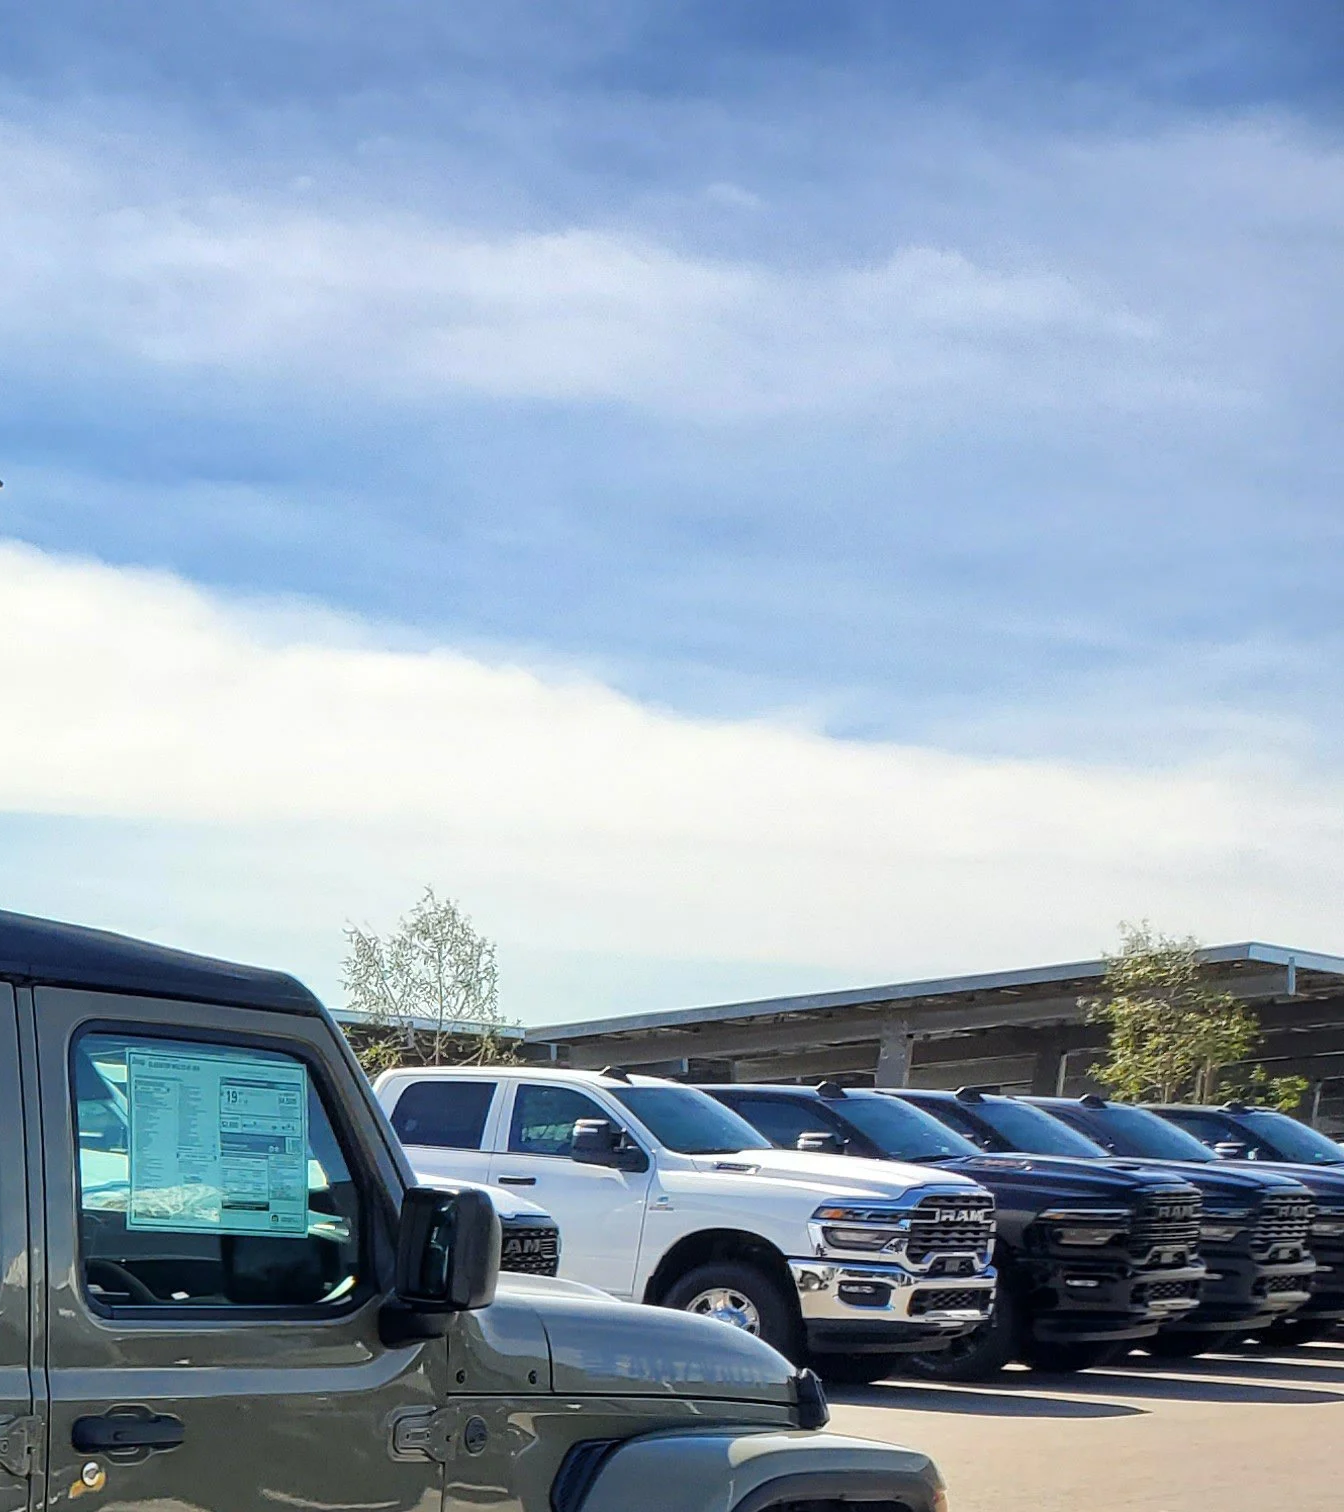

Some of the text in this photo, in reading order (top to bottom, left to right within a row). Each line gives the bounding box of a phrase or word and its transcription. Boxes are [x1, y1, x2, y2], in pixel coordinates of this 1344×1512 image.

[227, 1091, 238, 1103] 19
[940, 1209, 984, 1222] RAM
[502, 1239, 541, 1253] AM
